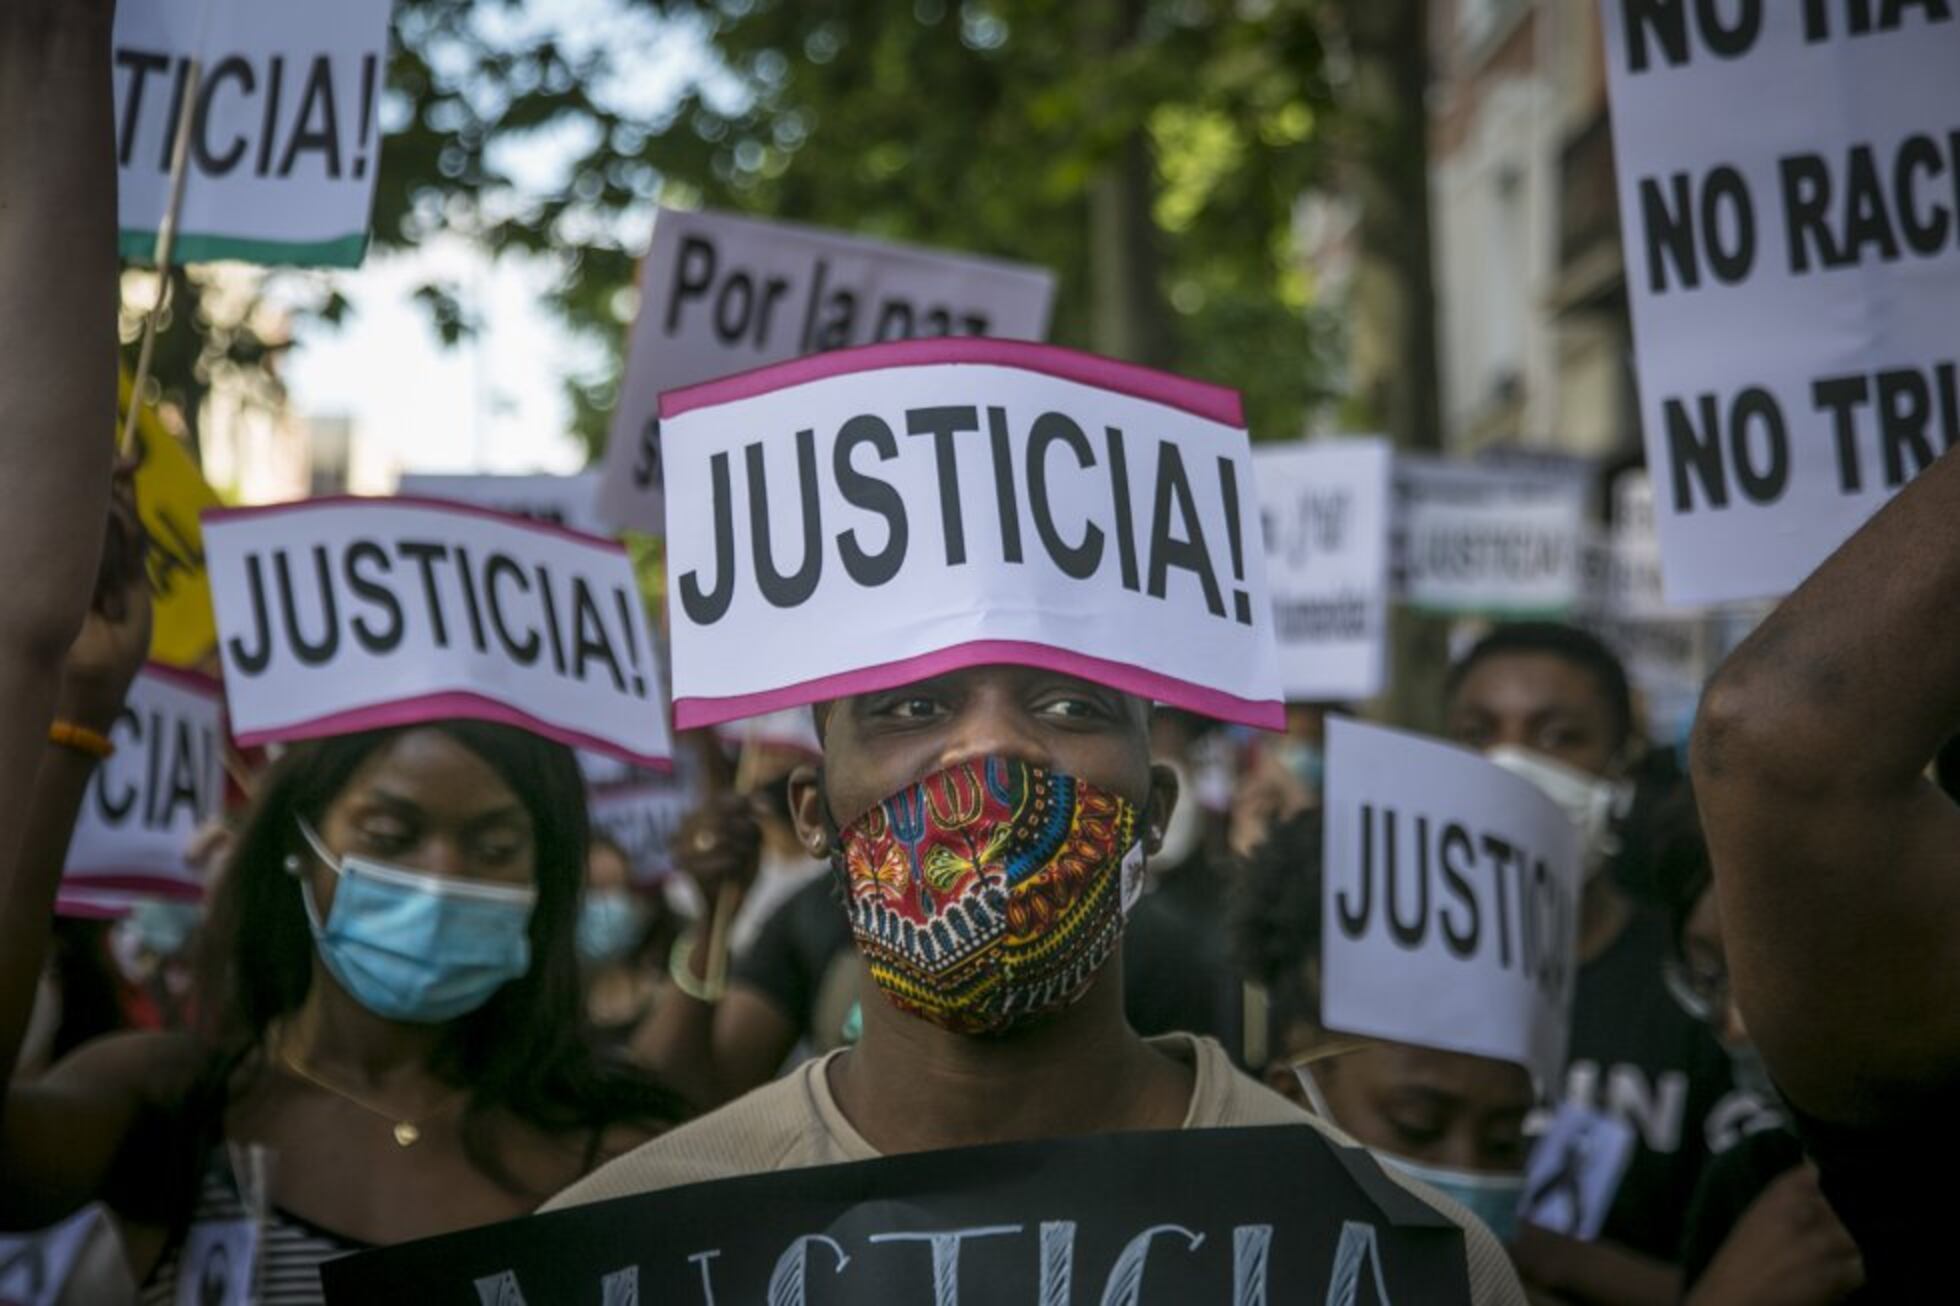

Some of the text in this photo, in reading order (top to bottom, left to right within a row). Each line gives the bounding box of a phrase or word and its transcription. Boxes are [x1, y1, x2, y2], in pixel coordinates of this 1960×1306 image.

[664, 233, 788, 352] Por
[1639, 163, 1756, 295] NO
[678, 404, 1253, 626] JUSTICIA!
[1664, 385, 1790, 513] NO
[228, 539, 650, 698] JUSTICIA!
